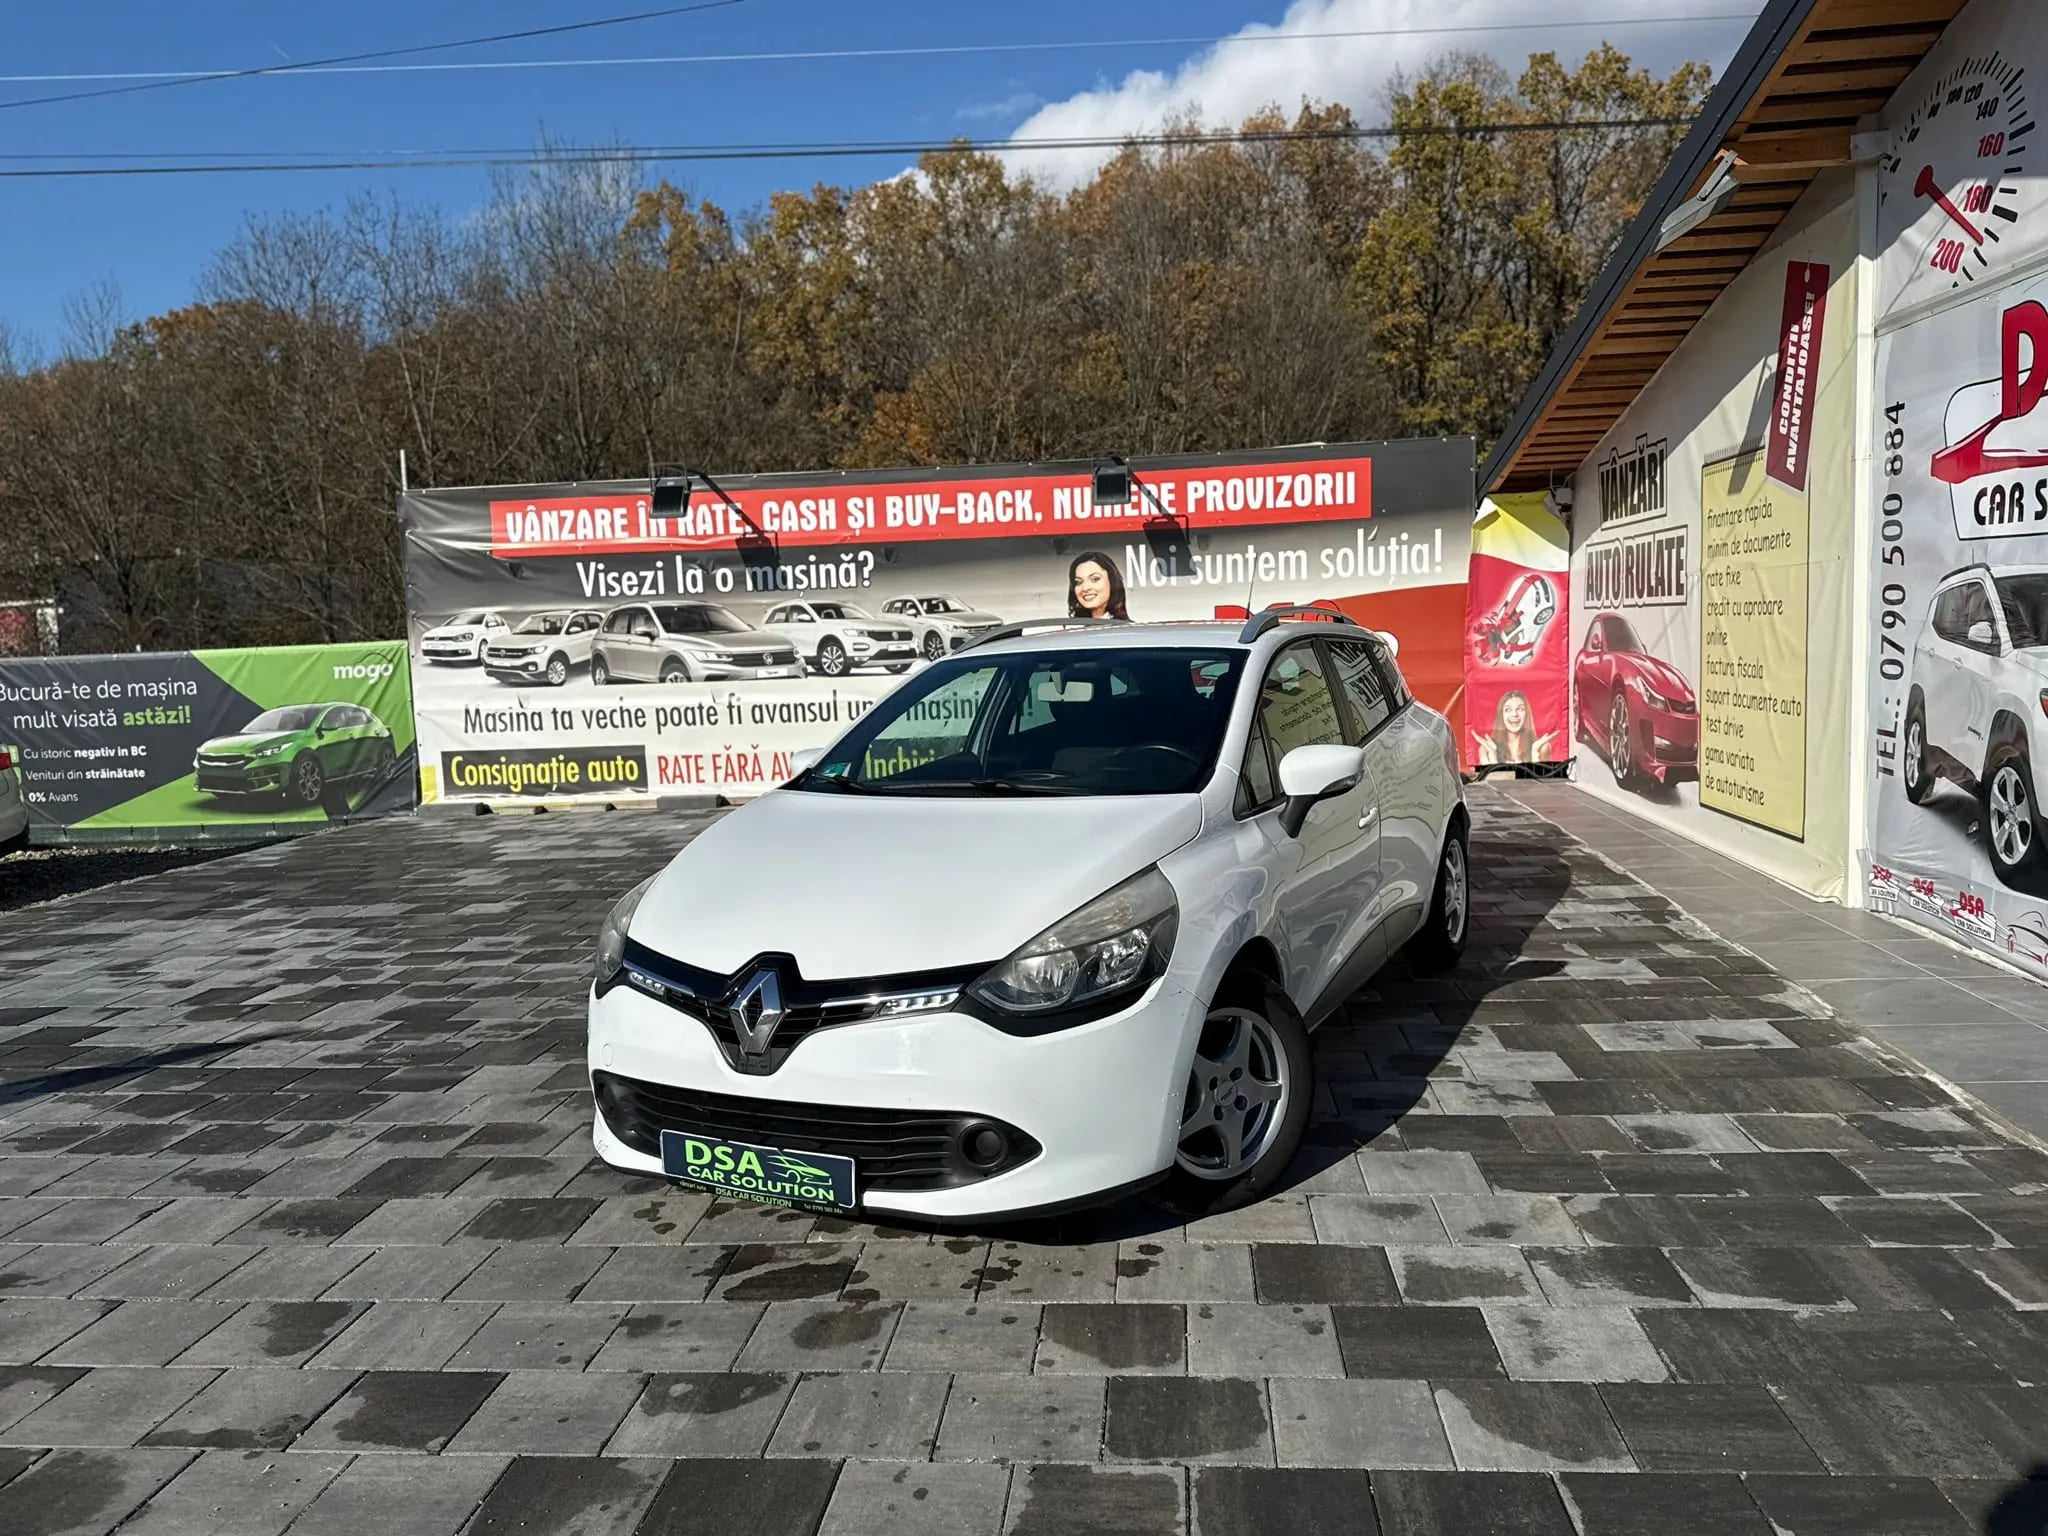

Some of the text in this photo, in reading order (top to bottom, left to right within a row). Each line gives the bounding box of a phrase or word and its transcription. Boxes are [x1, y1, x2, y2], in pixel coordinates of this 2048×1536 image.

[1964, 82, 1984, 104] 120
[1976, 96, 2000, 121] 140
[1977, 131, 2005, 158] 160
[1963, 185, 1994, 214] 180
[1930, 238, 1965, 274] 200
[1884, 400, 1906, 477] 884
[506, 505, 629, 544] VÂNZARE
[763, 499, 837, 533] CASH
[848, 496, 875, 537] ȘI
[1187, 471, 1356, 513] PROVIZORII
[1745, 496, 1772, 528] rapida
[1974, 478, 2048, 526] CAR S
[1731, 534, 1740, 555] de
[1743, 528, 1791, 553] documente
[1882, 493, 1906, 567] 500
[1125, 528, 1442, 588] Noi suntem soluția!
[1586, 535, 1685, 602] AUTO RULATE
[576, 550, 875, 598] Visezi la o mașină?
[1707, 565, 1740, 587] rate fixe
[1707, 595, 1783, 622] credit cu aprobare
[1880, 583, 1906, 680] 0790
[333, 662, 393, 684] mogo
[1707, 654, 1763, 679] factura fiscala
[96, 680, 121, 698] de
[128, 678, 198, 700] mașina
[1706, 685, 1802, 717] suport documente auto
[14, 705, 191, 729] mult visată astăzi!
[551, 708, 573, 731] ta
[584, 697, 646, 730] veche
[655, 702, 719, 735] poate
[727, 693, 742, 725] fi
[752, 689, 838, 724] avansul
[1706, 714, 1744, 738] test drive
[23, 748, 39, 759] Cu
[41, 747, 72, 759] istoric
[74, 747, 115, 762] negativ
[131, 746, 147, 757] BC
[658, 755, 705, 784] RATE
[712, 744, 764, 783] FĂRĂ
[1705, 747, 1754, 772] gama variata
[26, 768, 146, 781] Venituri din străinătate
[451, 754, 638, 792] Consignație auto
[1705, 769, 1765, 805] de autoturisme
[29, 792, 78, 802] 0% Avans
[1959, 891, 1984, 918] DSA
[685, 1139, 765, 1177] DSA
[687, 1166, 834, 1201] CAR SOLUTION
[716, 1187, 732, 1198] DSA
[733, 1190, 749, 1200] CAR
[751, 1192, 792, 1208] SOLUTION
